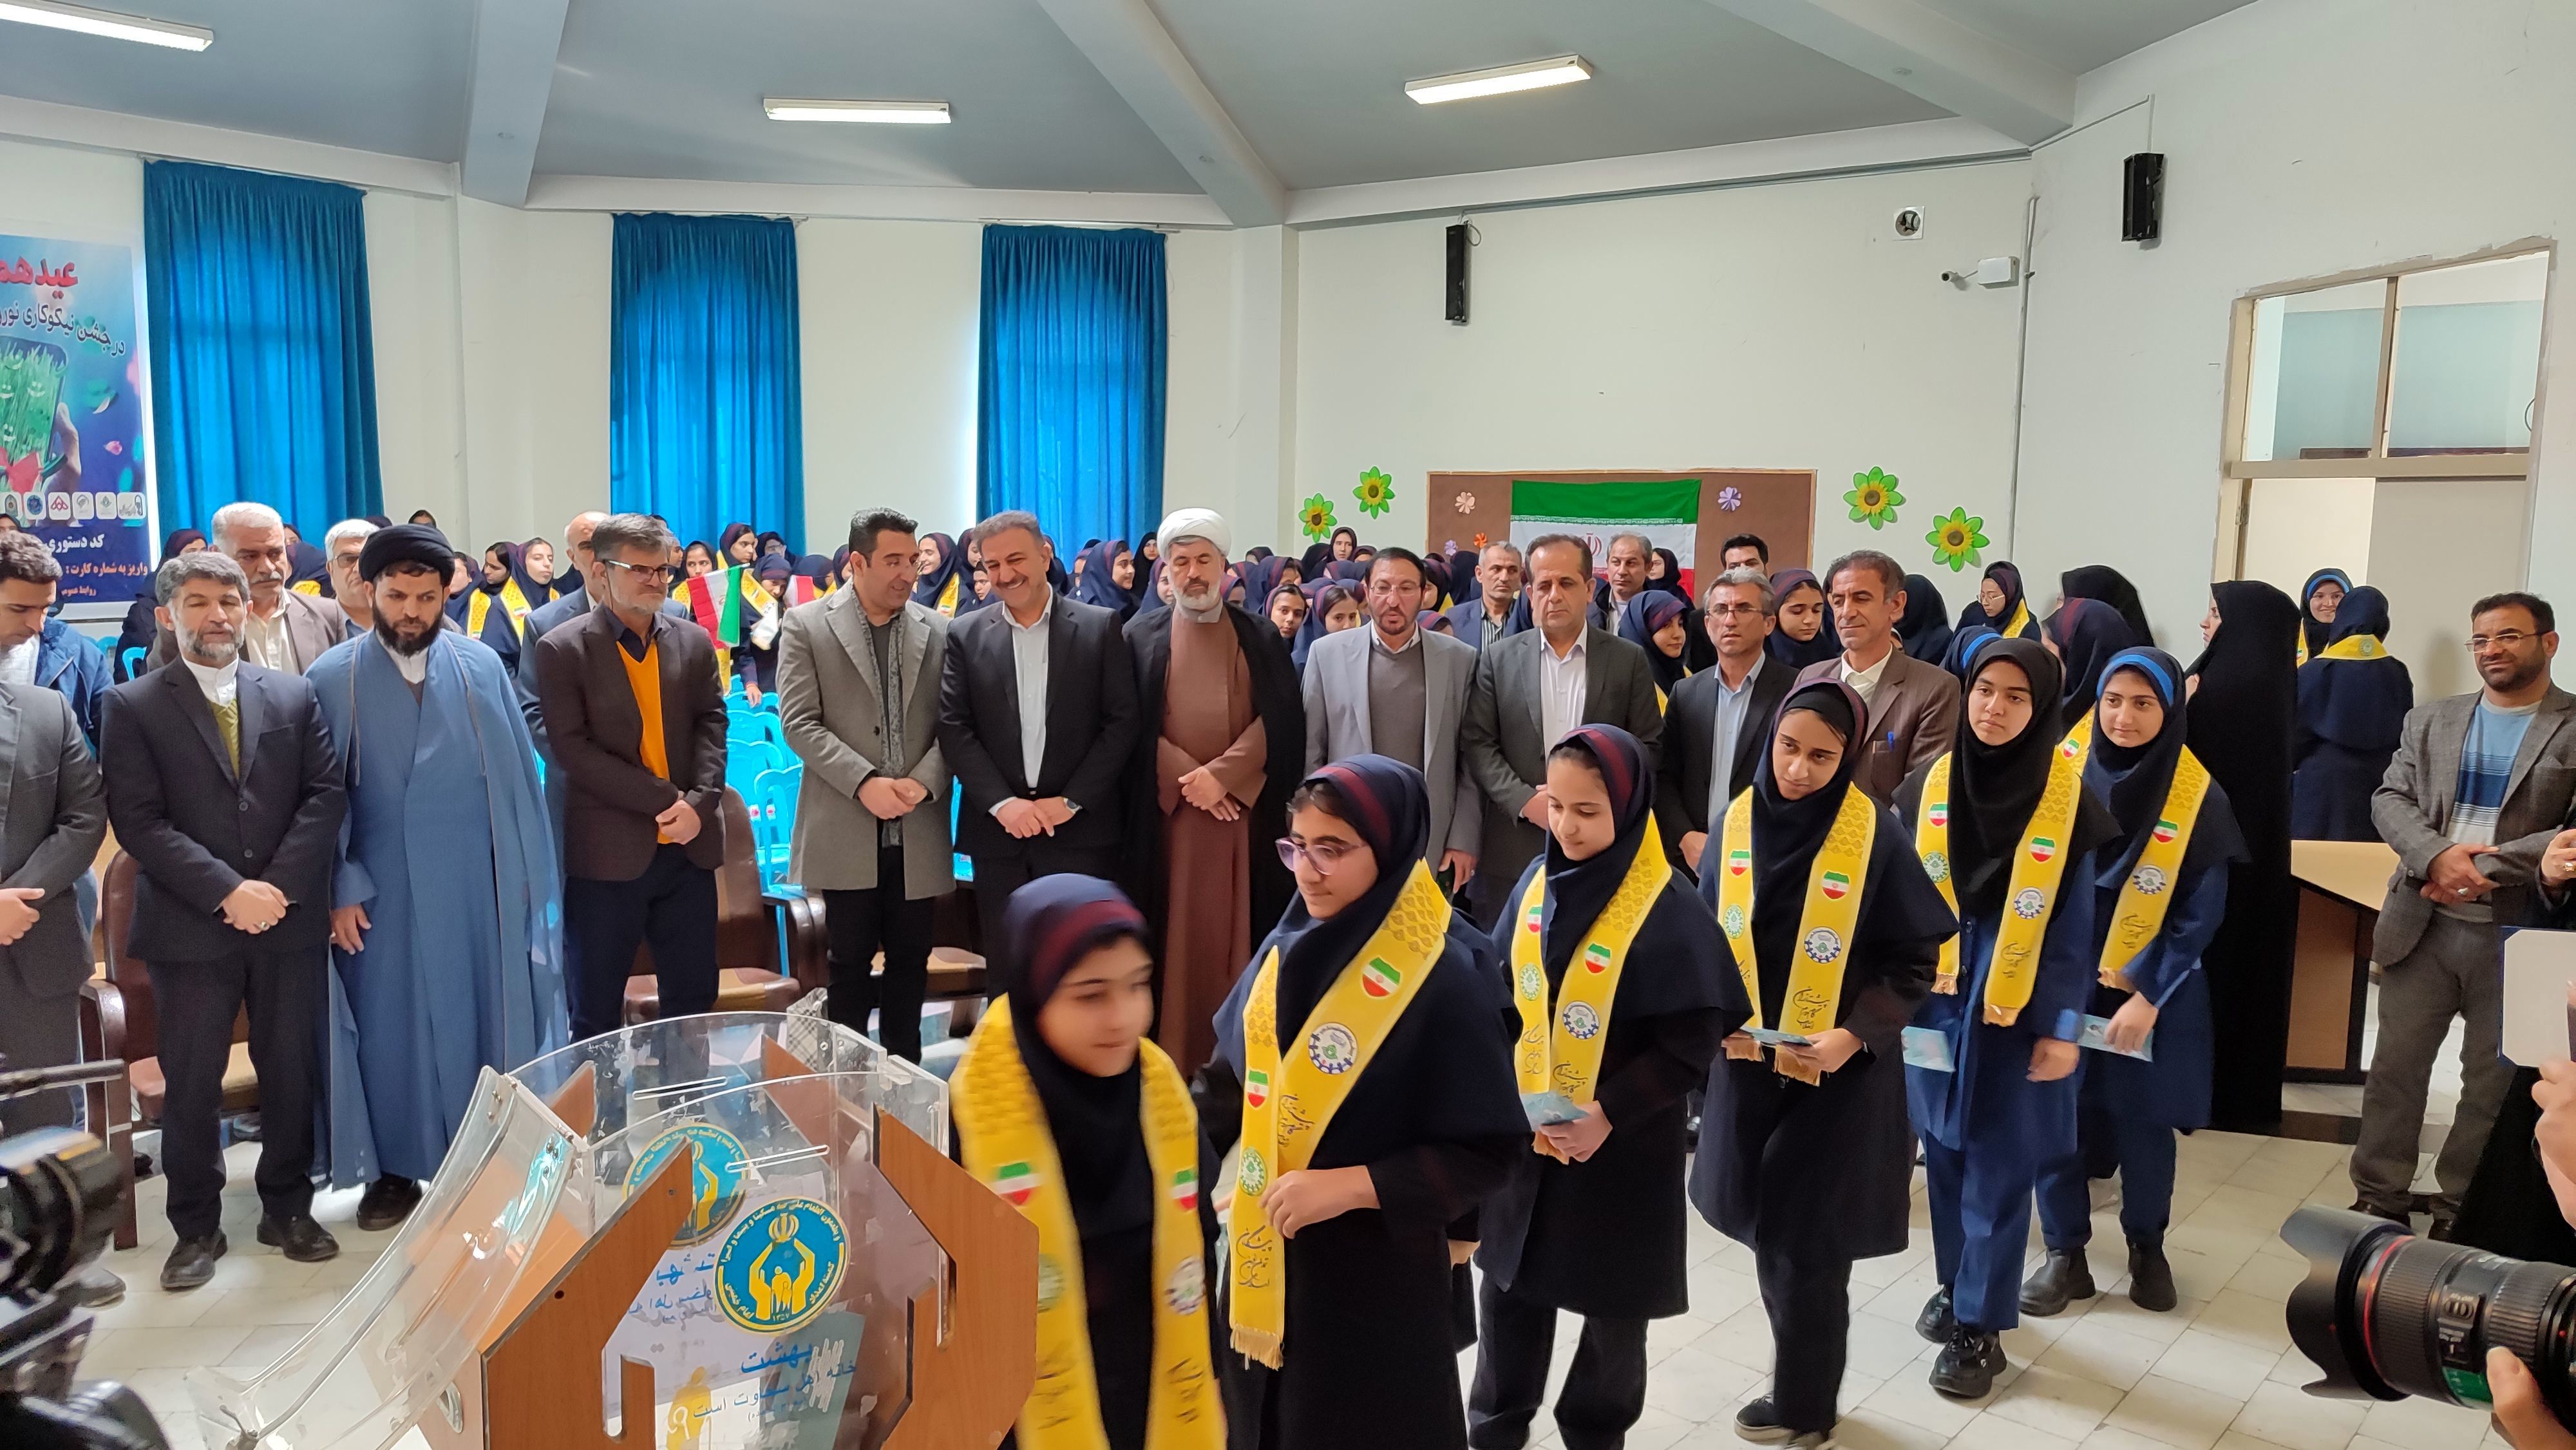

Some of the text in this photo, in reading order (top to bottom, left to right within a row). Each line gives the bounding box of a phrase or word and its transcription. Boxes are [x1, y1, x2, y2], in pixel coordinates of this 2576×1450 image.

[35, 258, 79, 299] عید
[23, 303, 74, 336] نیکوکاری
[77, 319, 111, 352] جشن
[111, 341, 125, 357] در
[46, 533, 105, 553] کد دستوری
[93, 561, 117, 577] شماره
[118, 565, 127, 576] به
[128, 561, 149, 577] واریز
[741, 1341, 813, 1374] بهشت
[693, 1397, 727, 1418] است
